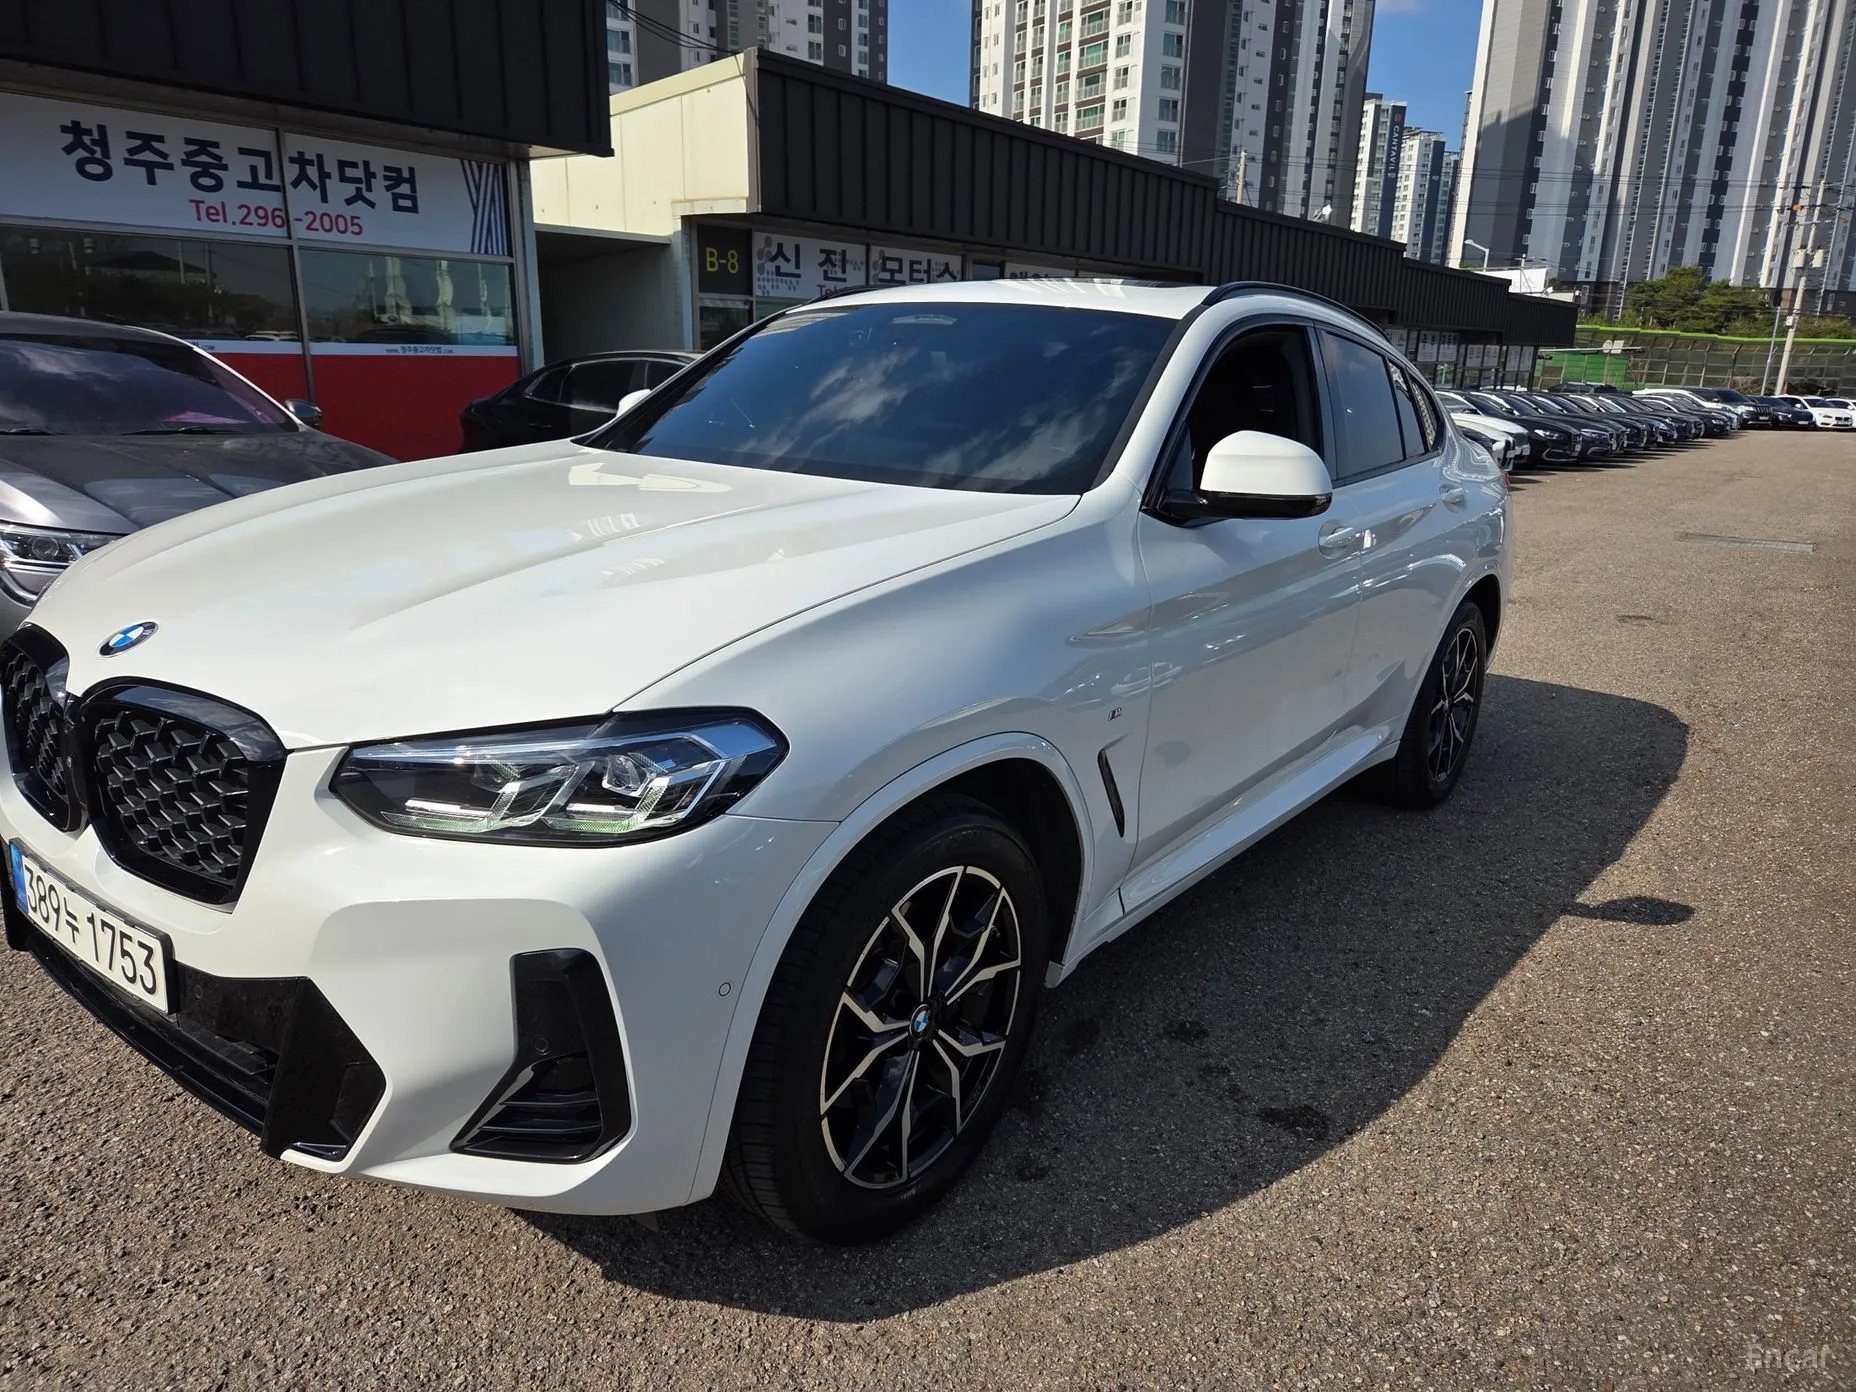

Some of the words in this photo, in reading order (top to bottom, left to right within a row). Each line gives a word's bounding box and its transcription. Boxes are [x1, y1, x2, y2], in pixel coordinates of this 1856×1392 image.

[59, 120, 419, 214] 청주중고차닷컴
[706, 247, 739, 275] B-8
[24, 864, 80, 944] 389누
[86, 912, 157, 995] 1753
